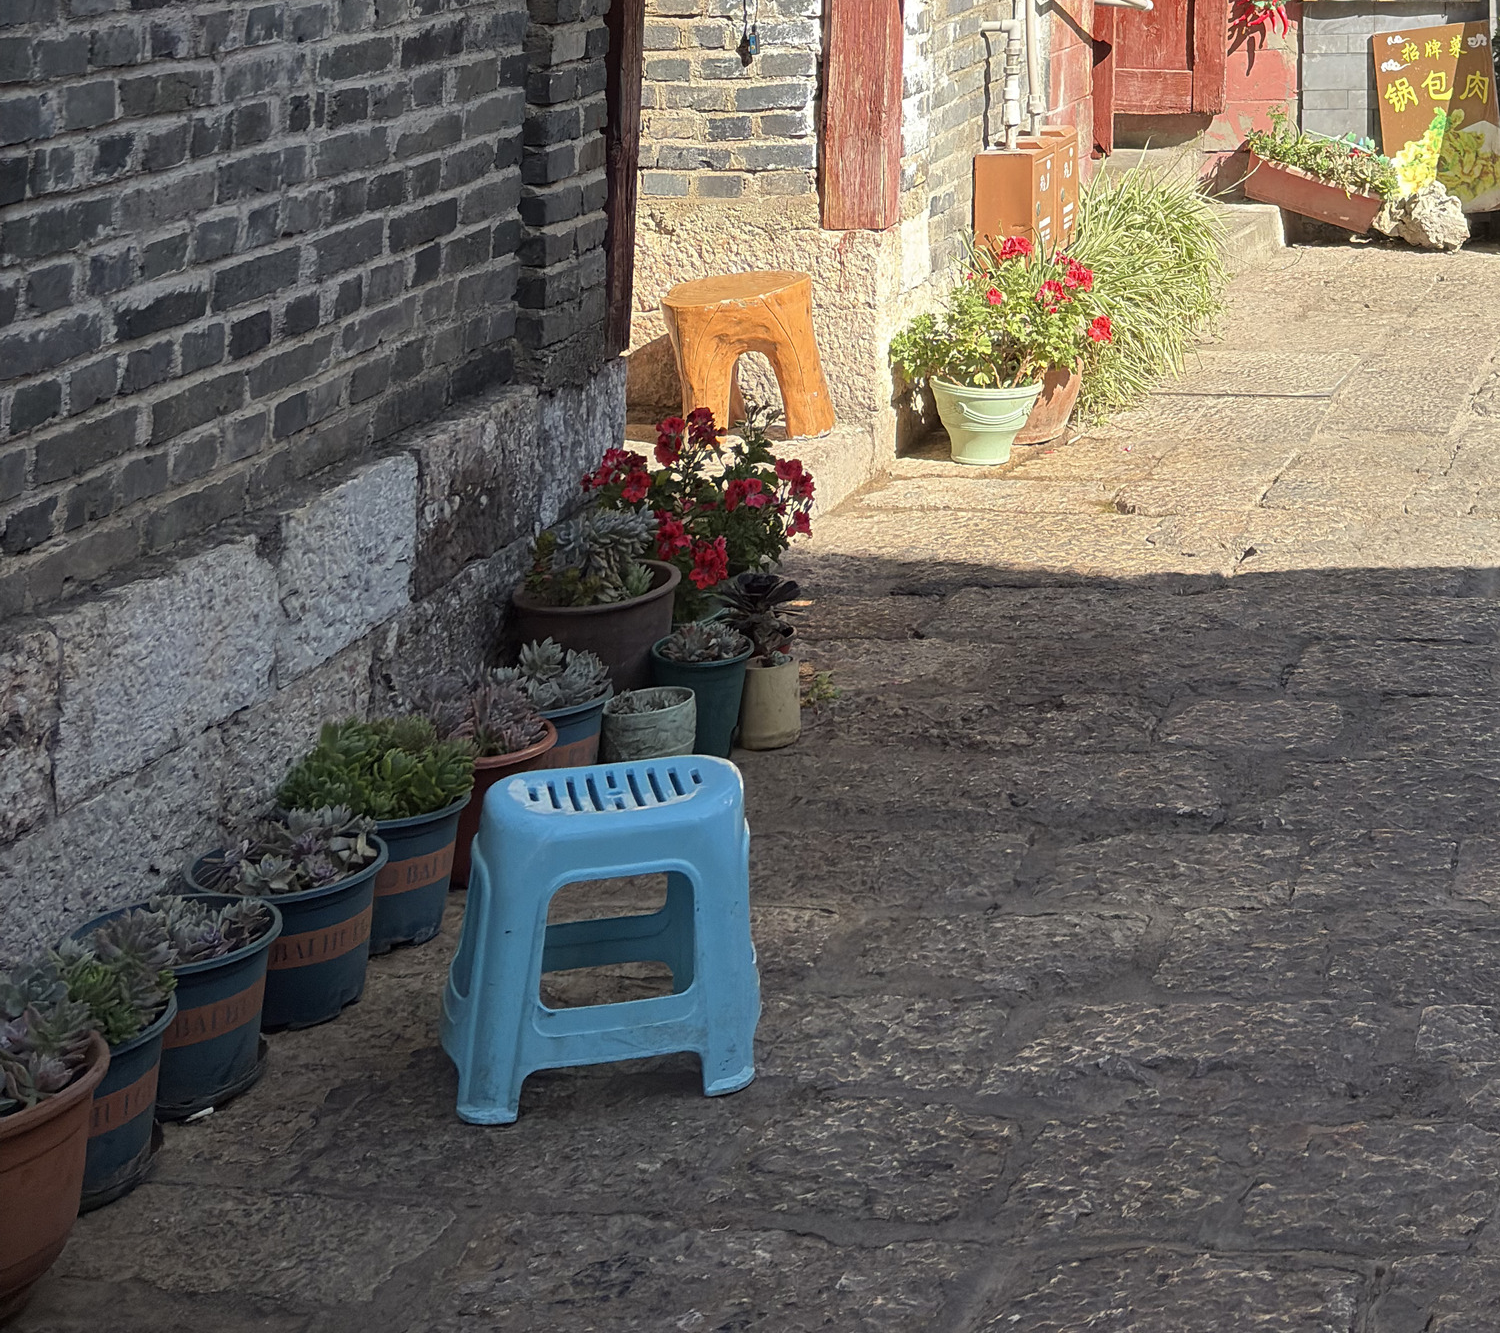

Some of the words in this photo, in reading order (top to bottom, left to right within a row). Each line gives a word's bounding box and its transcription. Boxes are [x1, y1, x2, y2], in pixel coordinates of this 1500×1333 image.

[1400, 35, 1468, 63] 招牌菜
[1384, 69, 1490, 113] 锅包肉
